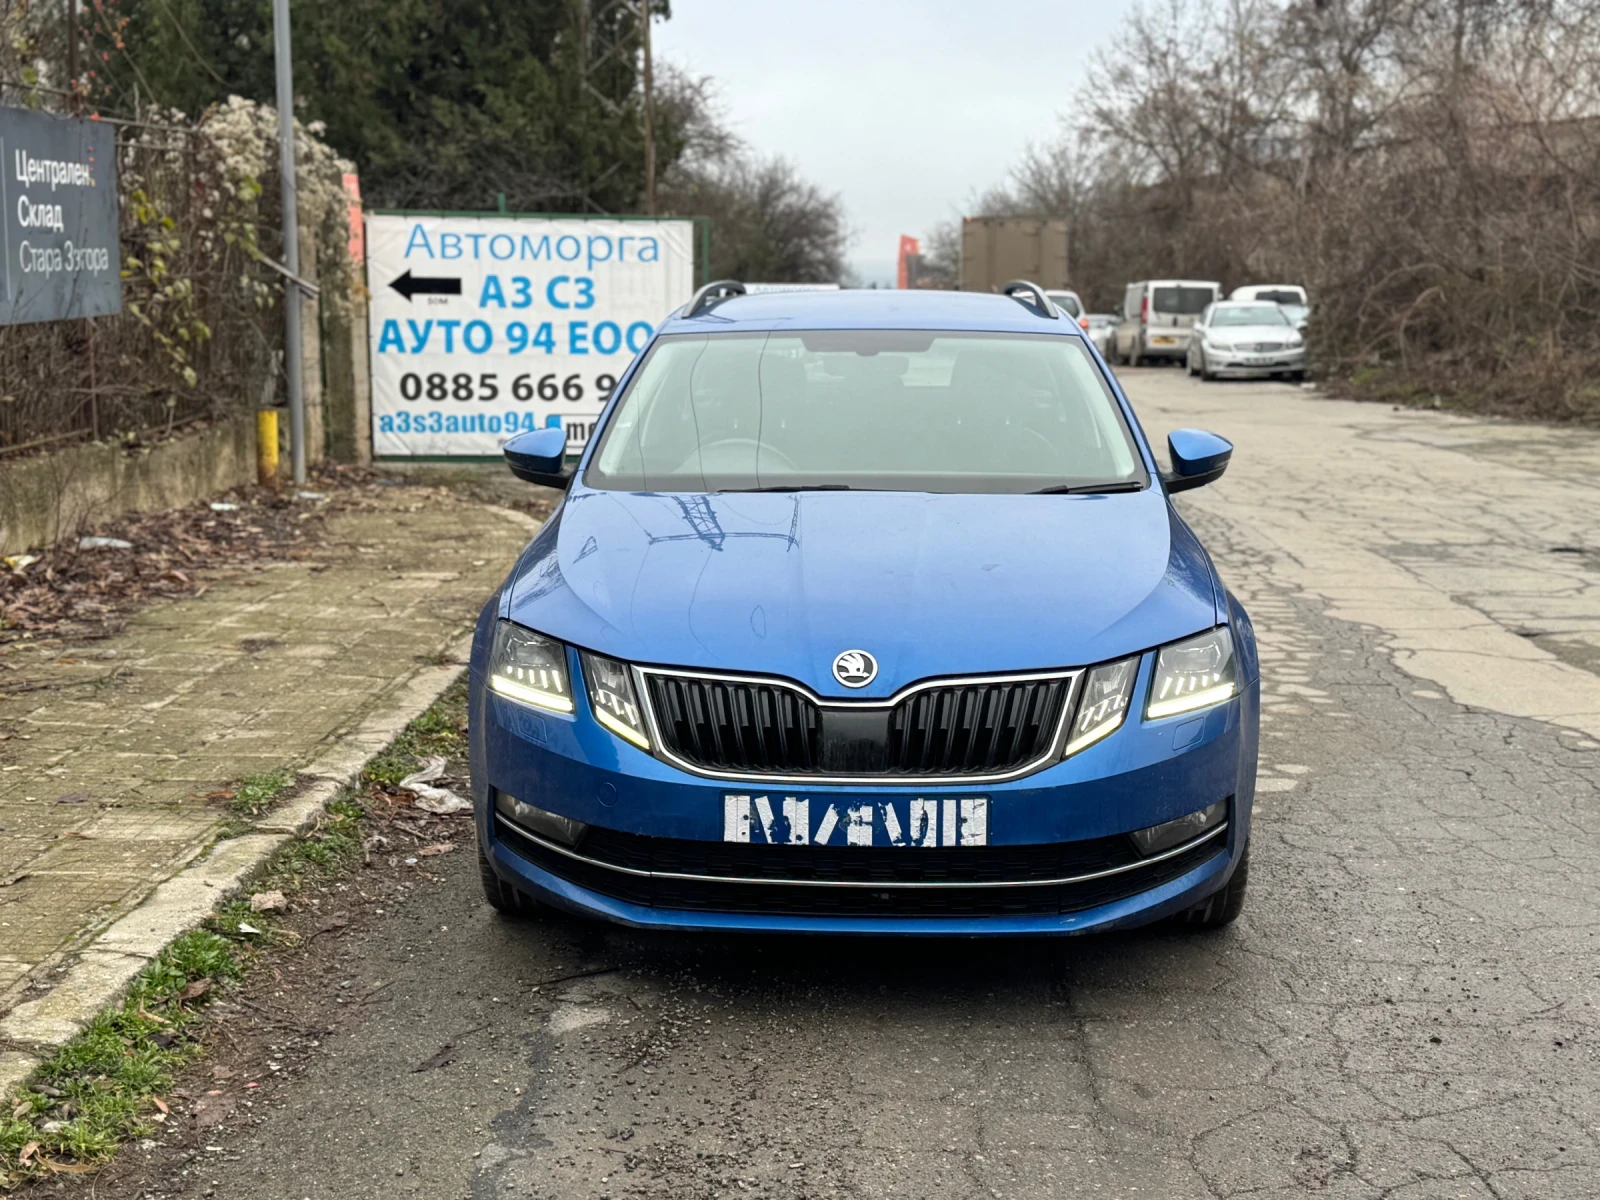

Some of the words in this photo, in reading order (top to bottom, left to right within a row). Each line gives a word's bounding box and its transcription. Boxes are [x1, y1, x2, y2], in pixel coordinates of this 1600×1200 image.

[15, 148, 89, 192] Централен
[18, 194, 64, 233] Склад
[20, 240, 62, 279] Стара
[404, 223, 660, 271] Автоморга
[377, 319, 494, 355] АУТО
[505, 320, 557, 356] 94
[399, 373, 499, 402] 0885
[511, 373, 584, 402] 666
[378, 410, 536, 434] a3s3auto94
